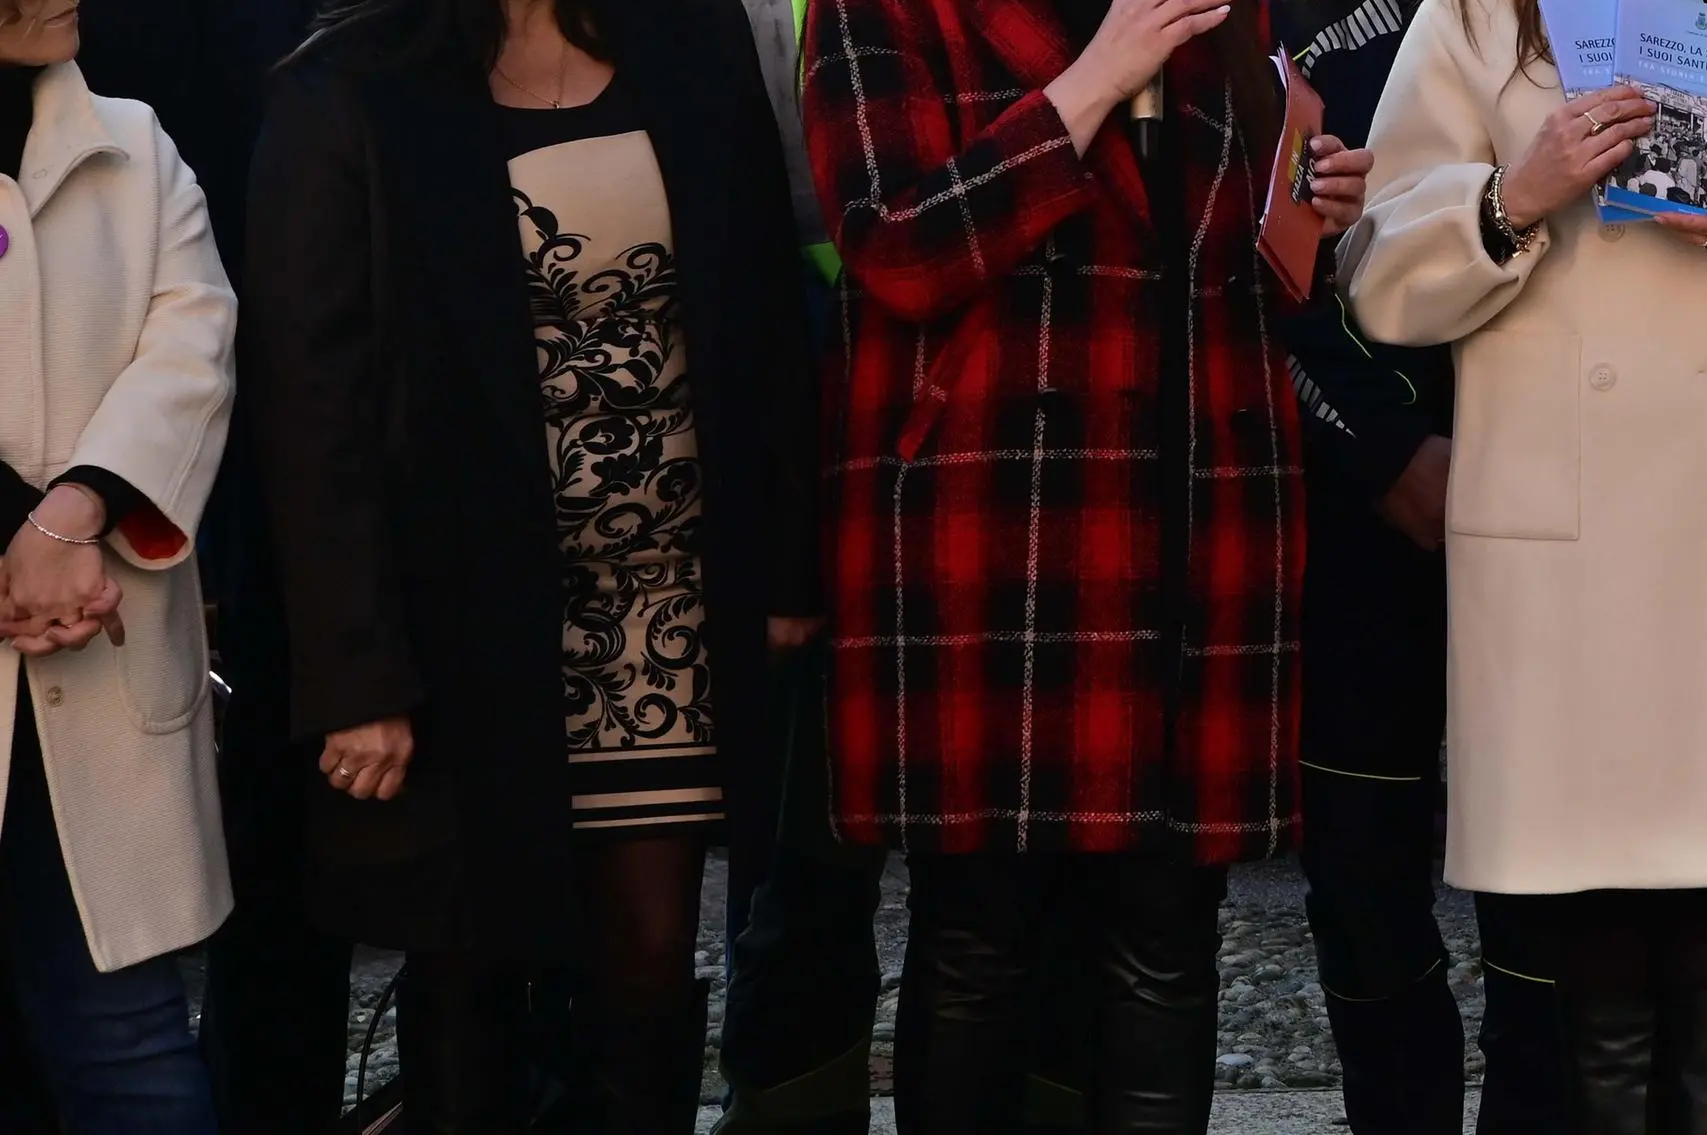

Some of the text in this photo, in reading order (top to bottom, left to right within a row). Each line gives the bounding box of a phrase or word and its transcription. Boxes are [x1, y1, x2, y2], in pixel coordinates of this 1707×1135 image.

[1640, 32, 1687, 54] SAREZZO,
[1690, 45, 1703, 57] LA
[1579, 51, 1613, 63] I SUOI
[1647, 48, 1673, 63] SUOI
[1291, 164, 1304, 202] PIAZZA
